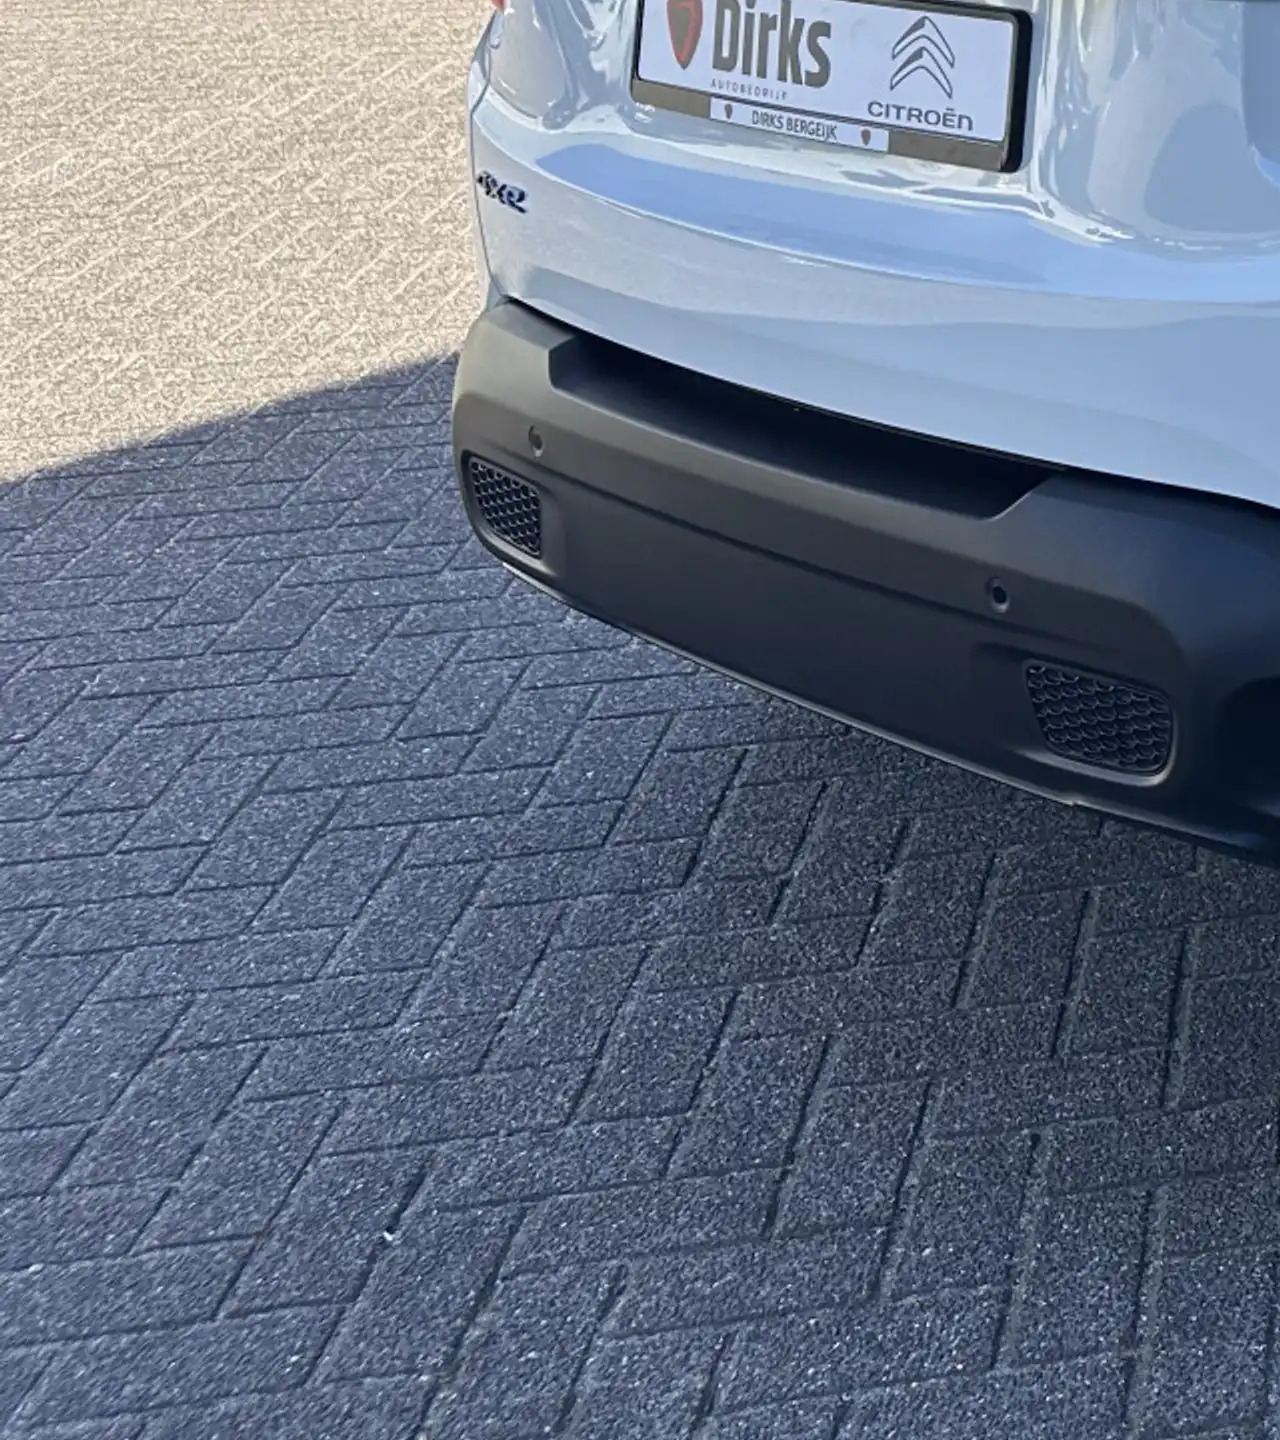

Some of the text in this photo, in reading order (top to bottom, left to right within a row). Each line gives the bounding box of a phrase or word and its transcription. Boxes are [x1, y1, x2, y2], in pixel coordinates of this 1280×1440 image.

[711, 77, 789, 102] AUTOBEDRIJF
[751, 109, 838, 141] DIRKS BERGEIJK
